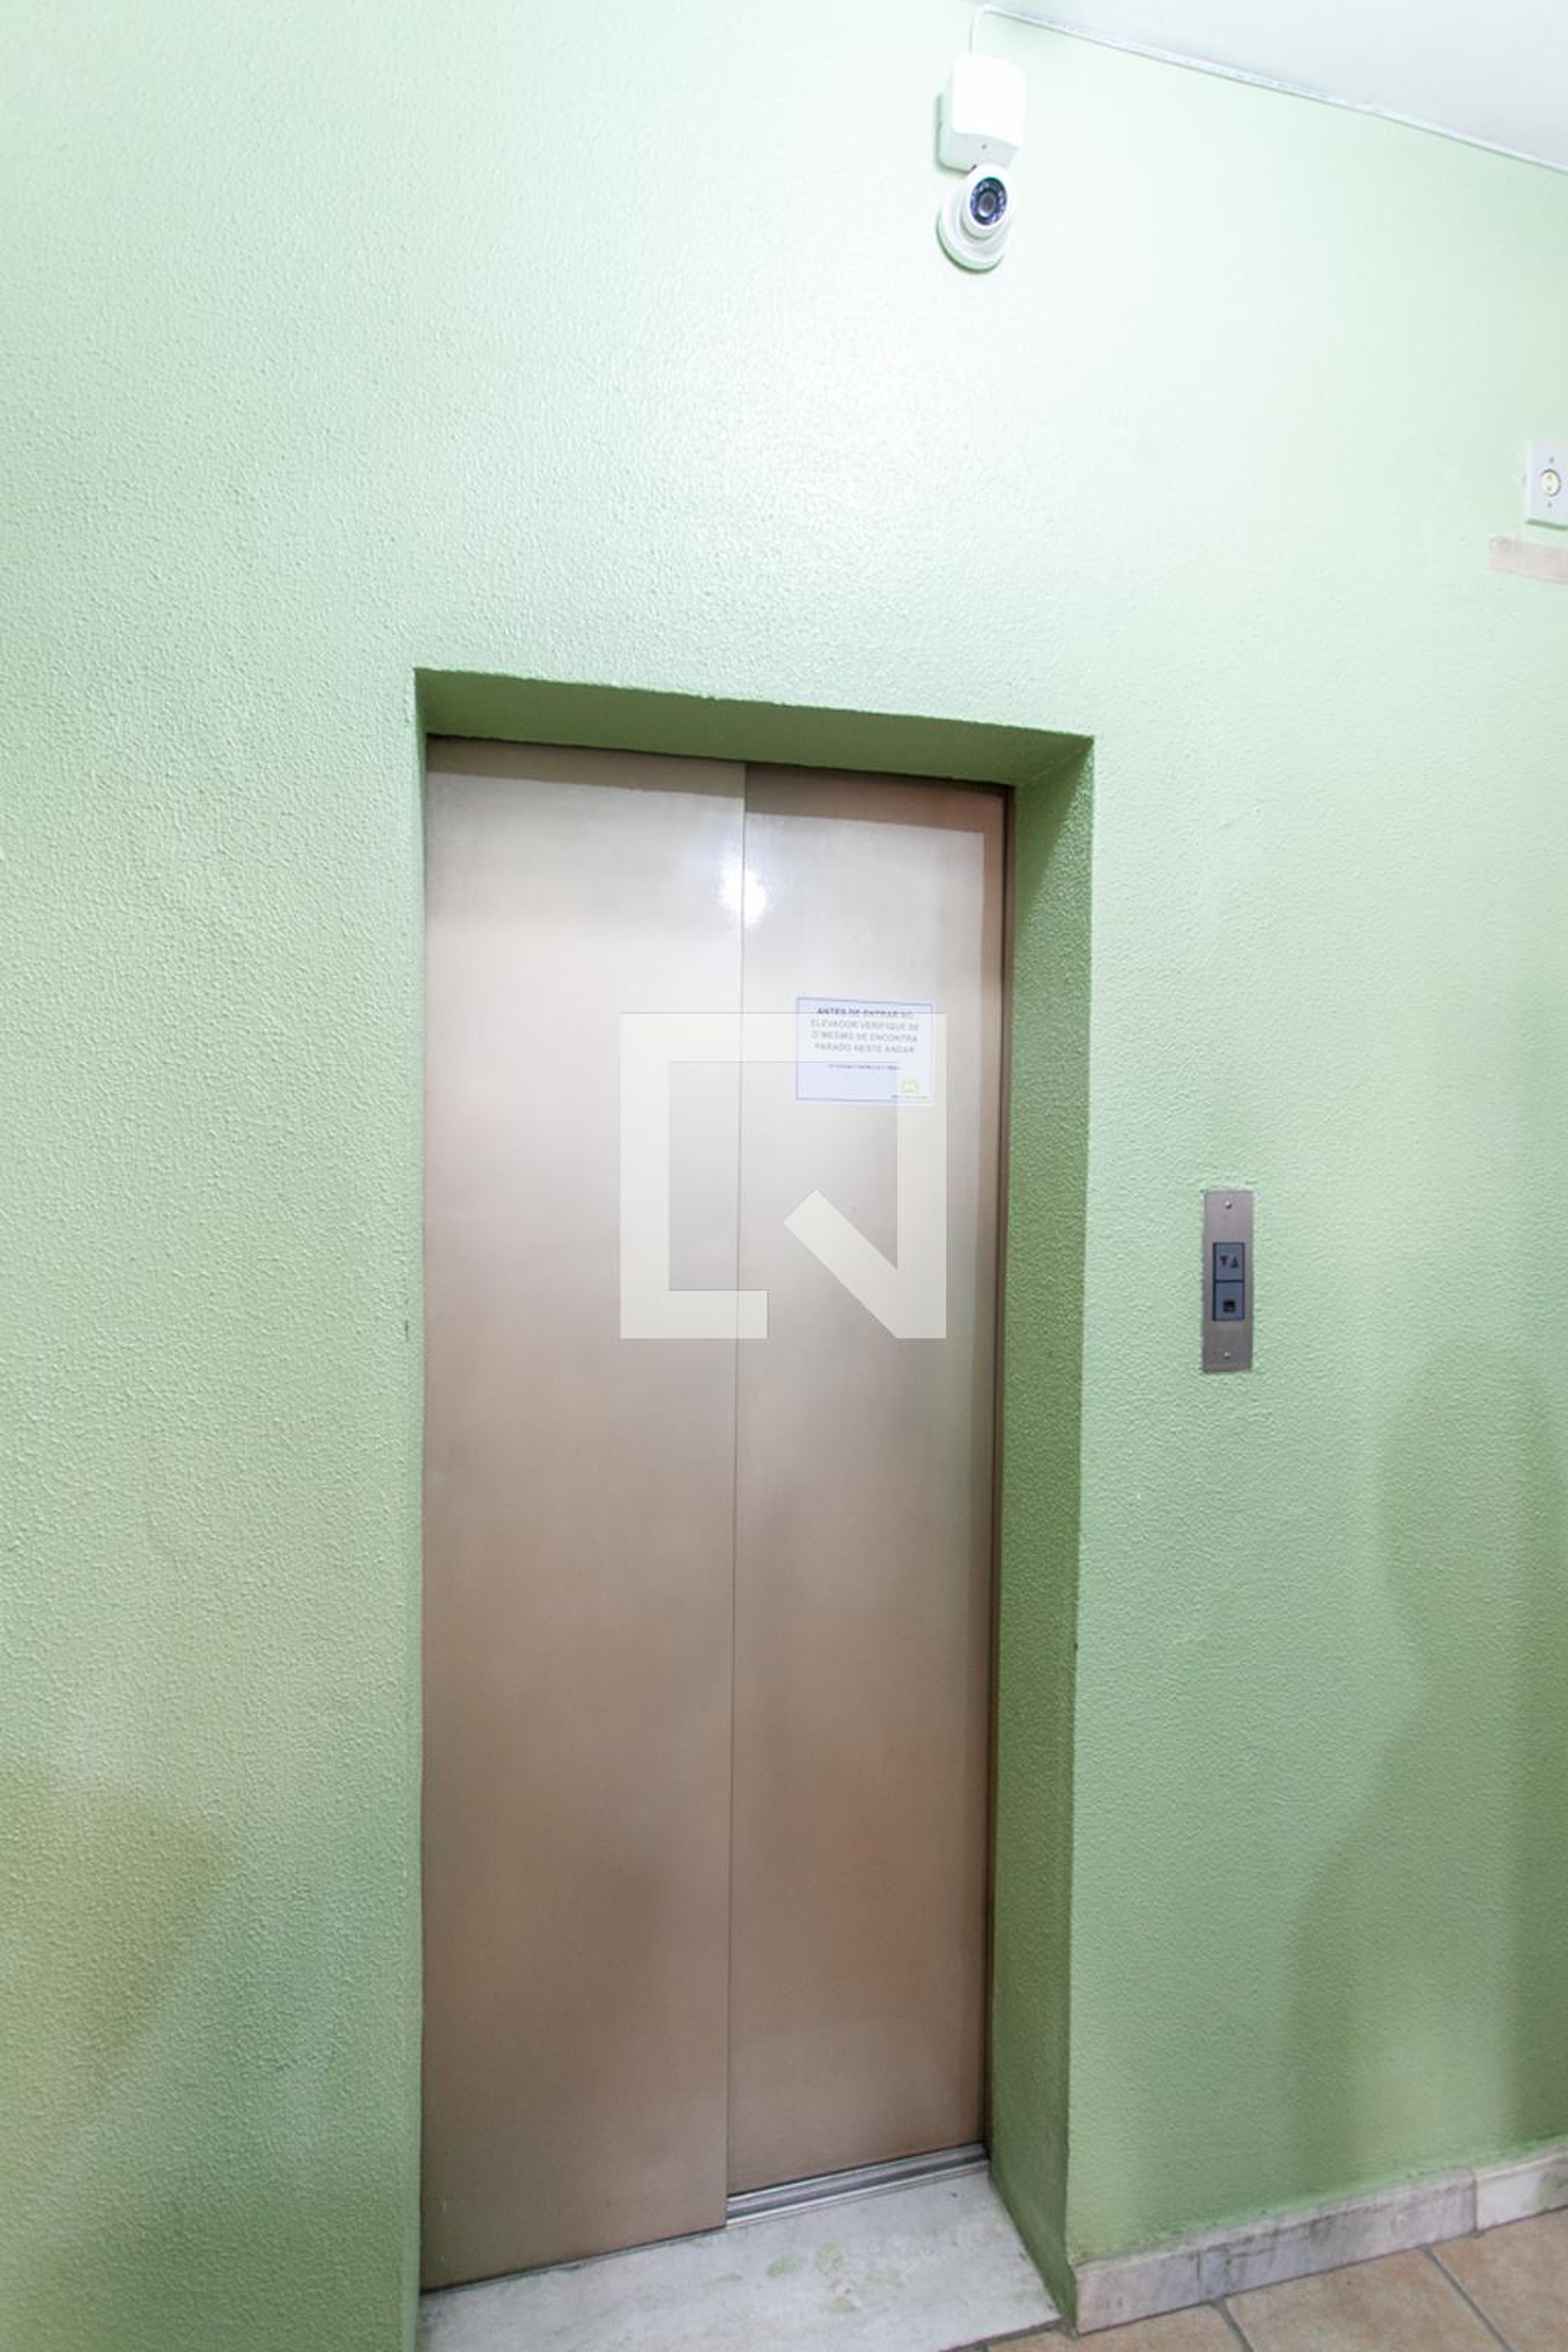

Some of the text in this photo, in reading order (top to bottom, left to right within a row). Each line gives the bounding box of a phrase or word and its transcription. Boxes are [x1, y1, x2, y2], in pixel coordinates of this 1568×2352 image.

[811, 1020, 919, 1031] ELEVADOR VERIFIQUE SE
[822, 1031, 854, 1040] MESMO
[857, 1032, 868, 1041] SE
[870, 1033, 918, 1042] ENCONTRA
[815, 1043, 914, 1054] PARADO NESTE ANDAR
